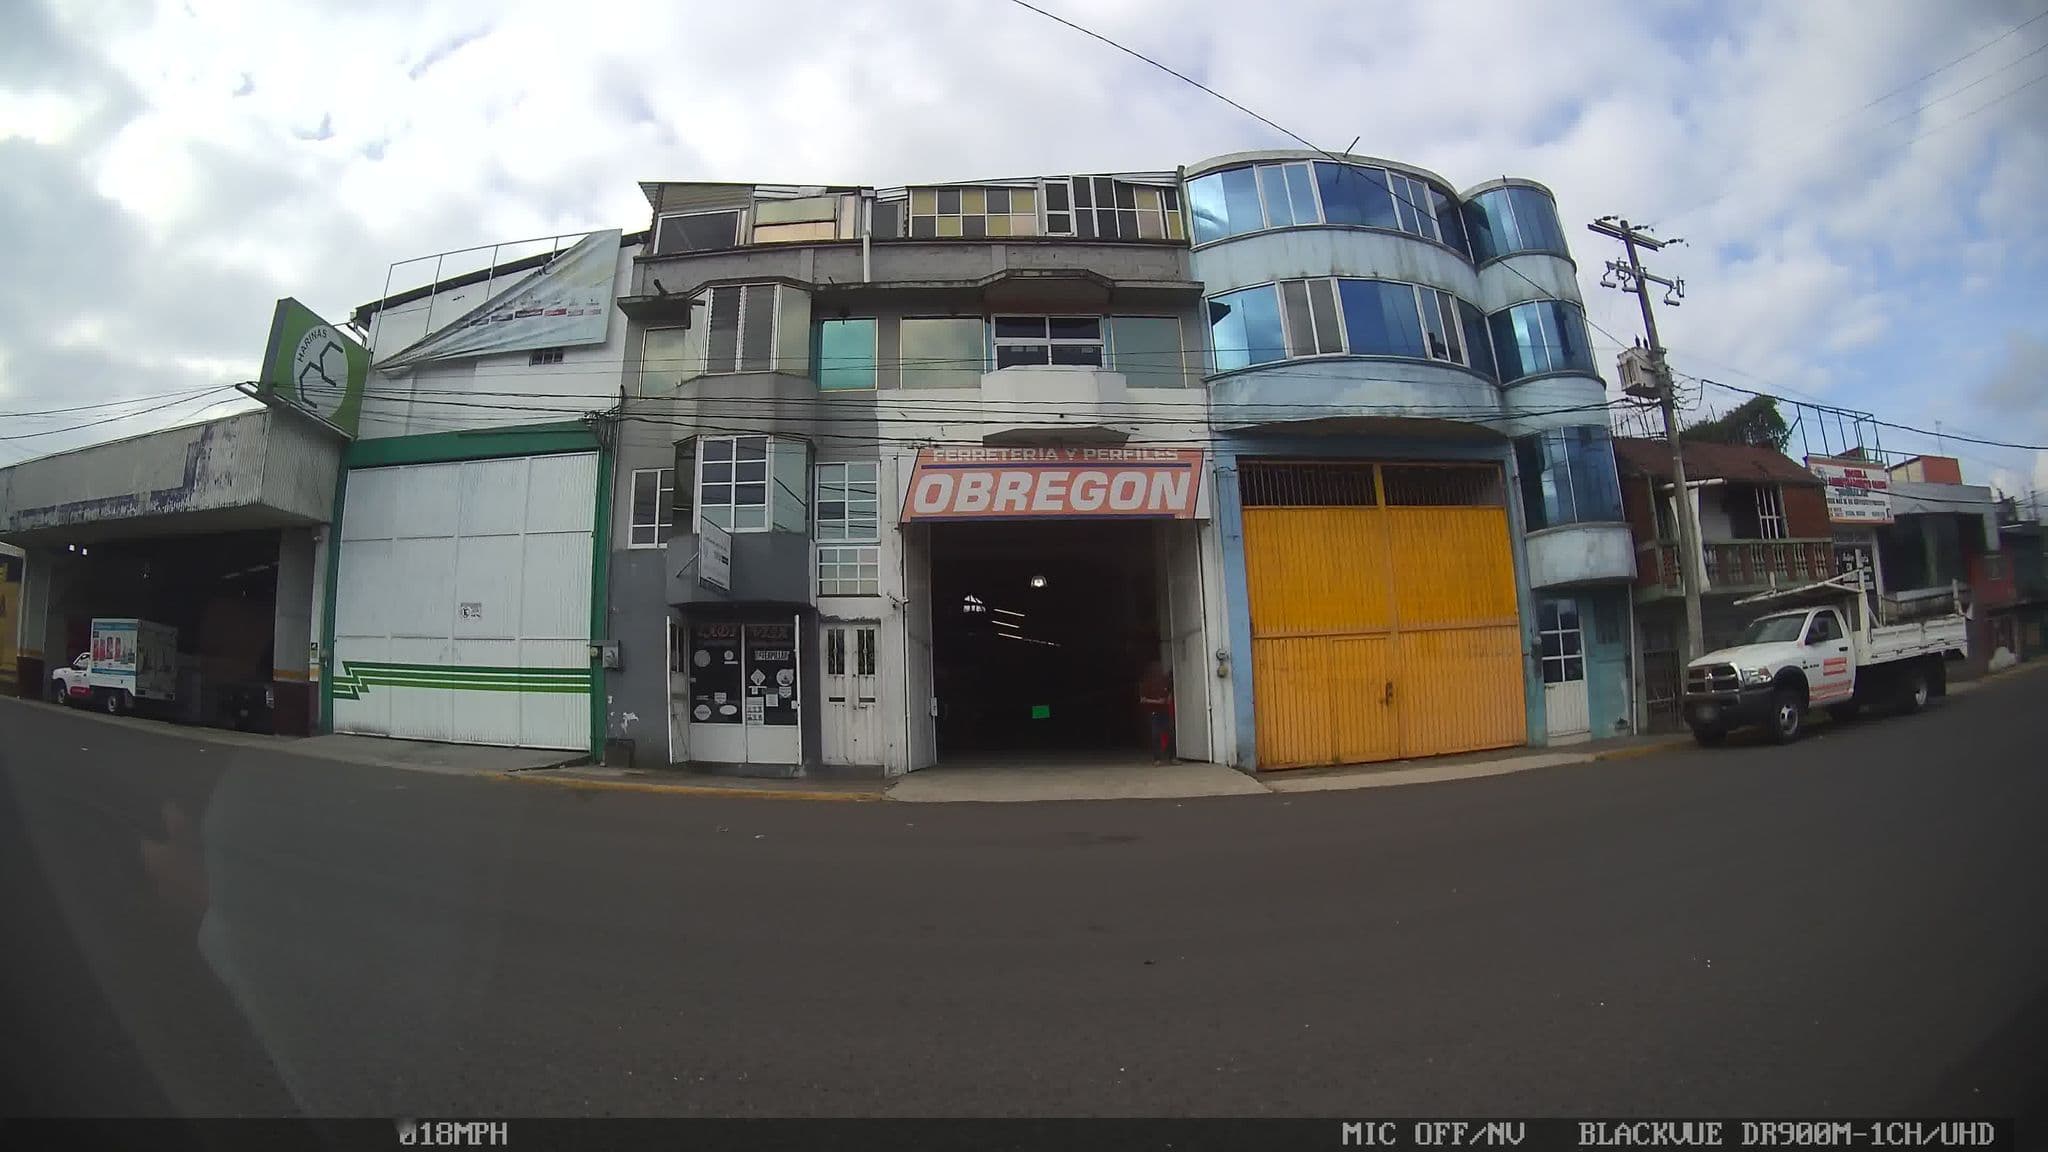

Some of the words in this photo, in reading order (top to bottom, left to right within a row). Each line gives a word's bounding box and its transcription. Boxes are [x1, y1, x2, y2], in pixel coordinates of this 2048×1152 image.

[297, 328, 328, 363] HARINAS
[933, 448, 1060, 461] FERRETERIA
[1066, 448, 1077, 461] Y
[1084, 448, 1178, 460] PERFILES
[913, 471, 1191, 513] OBREGON
